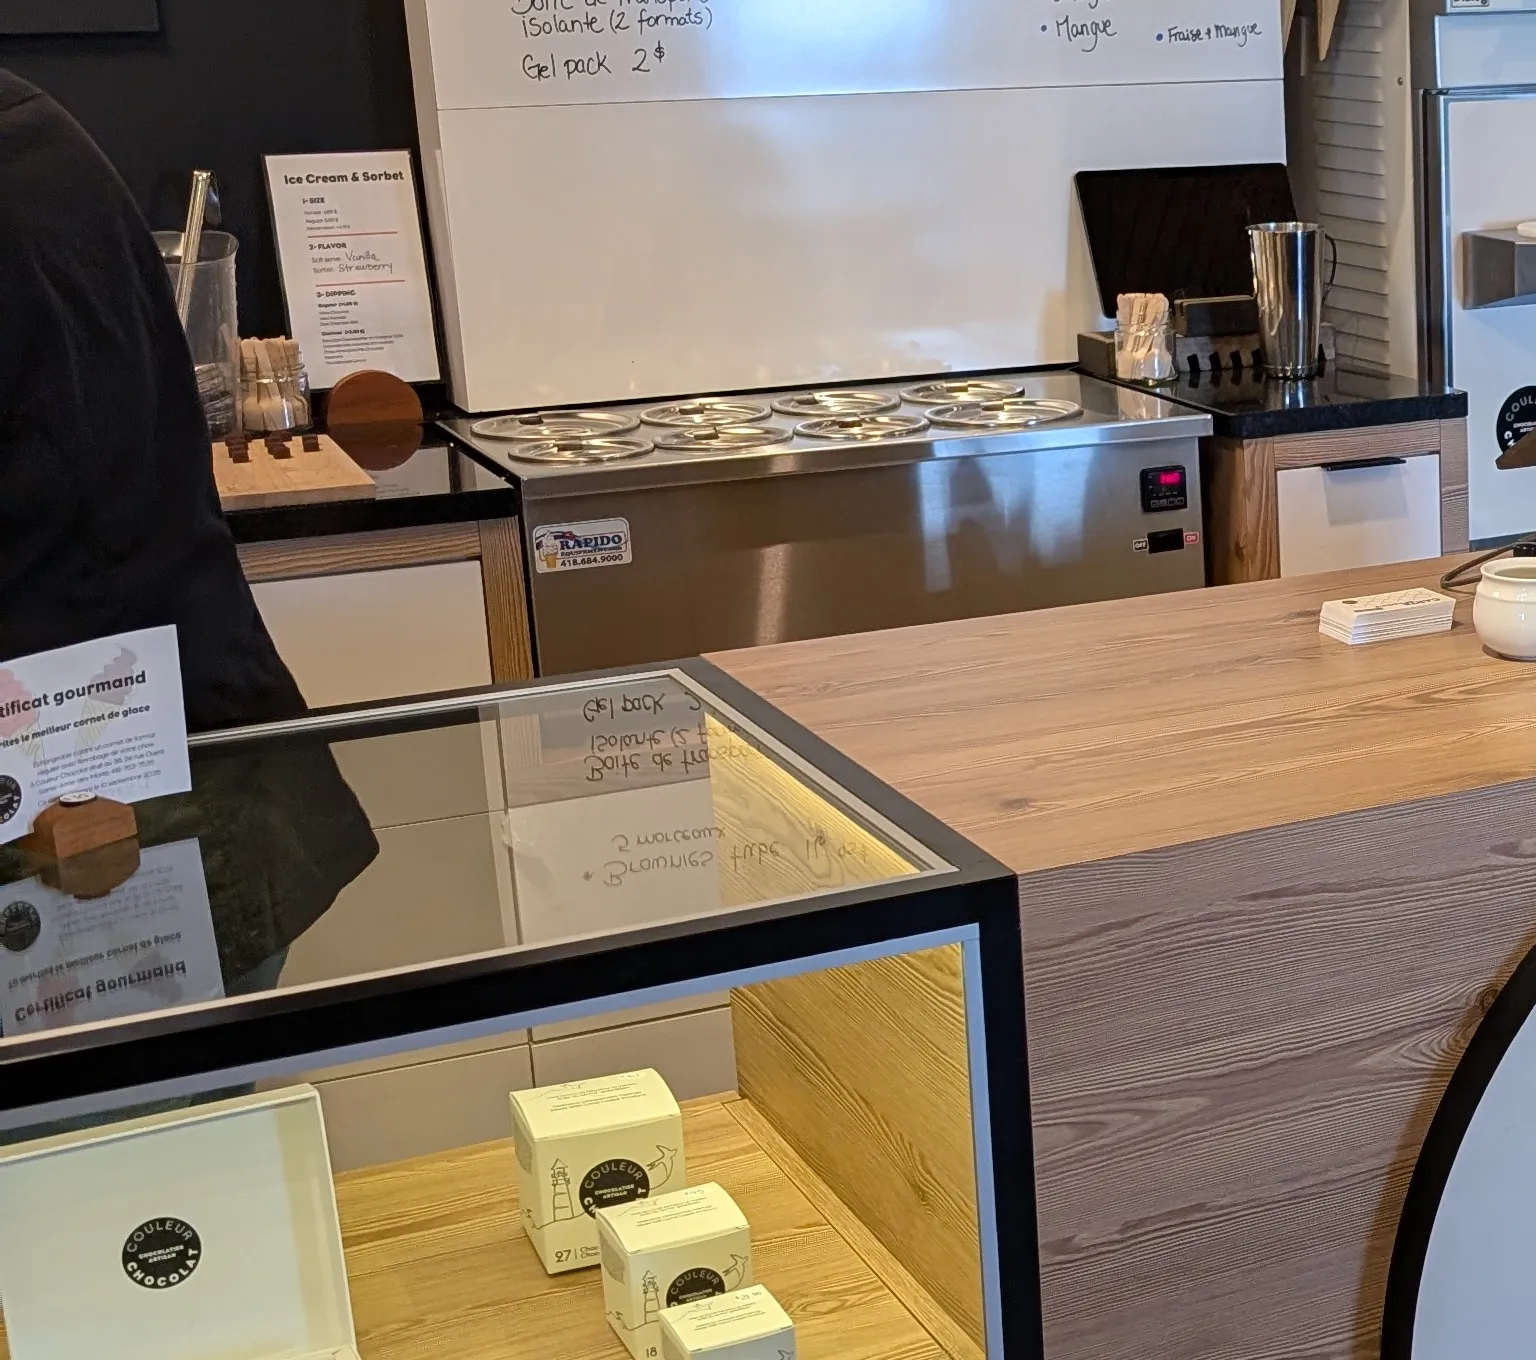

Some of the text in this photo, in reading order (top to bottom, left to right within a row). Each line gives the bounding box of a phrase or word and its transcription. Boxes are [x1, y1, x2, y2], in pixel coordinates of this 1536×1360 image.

[522, 11, 604, 38] isolante
[638, 8, 712, 34] formats)
[1056, 15, 1117, 52] Mangue
[1168, 26, 1203, 42] Fraise
[522, 52, 556, 81] Gel
[567, 51, 611, 80] pack
[284, 171, 404, 184] Ice Cream & Sorbet
[339, 263, 392, 274] Strawberry
[560, 535, 622, 550] RAPIDO
[561, 554, 623, 567] 418.684.9000
[53, 671, 146, 706] gourmand
[32, 722, 71, 738] meilleur
[73, 713, 105, 728] cornet
[108, 710, 120, 719] de
[122, 705, 150, 718] glace
[585, 1161, 643, 1189] COULEUR
[127, 1220, 192, 1252] COULEUR
[127, 1249, 198, 1286] CHOCOLAT
[555, 1249, 572, 1262] 27
[671, 1270, 720, 1295] COULEUR
[646, 1347, 658, 1358] 18
